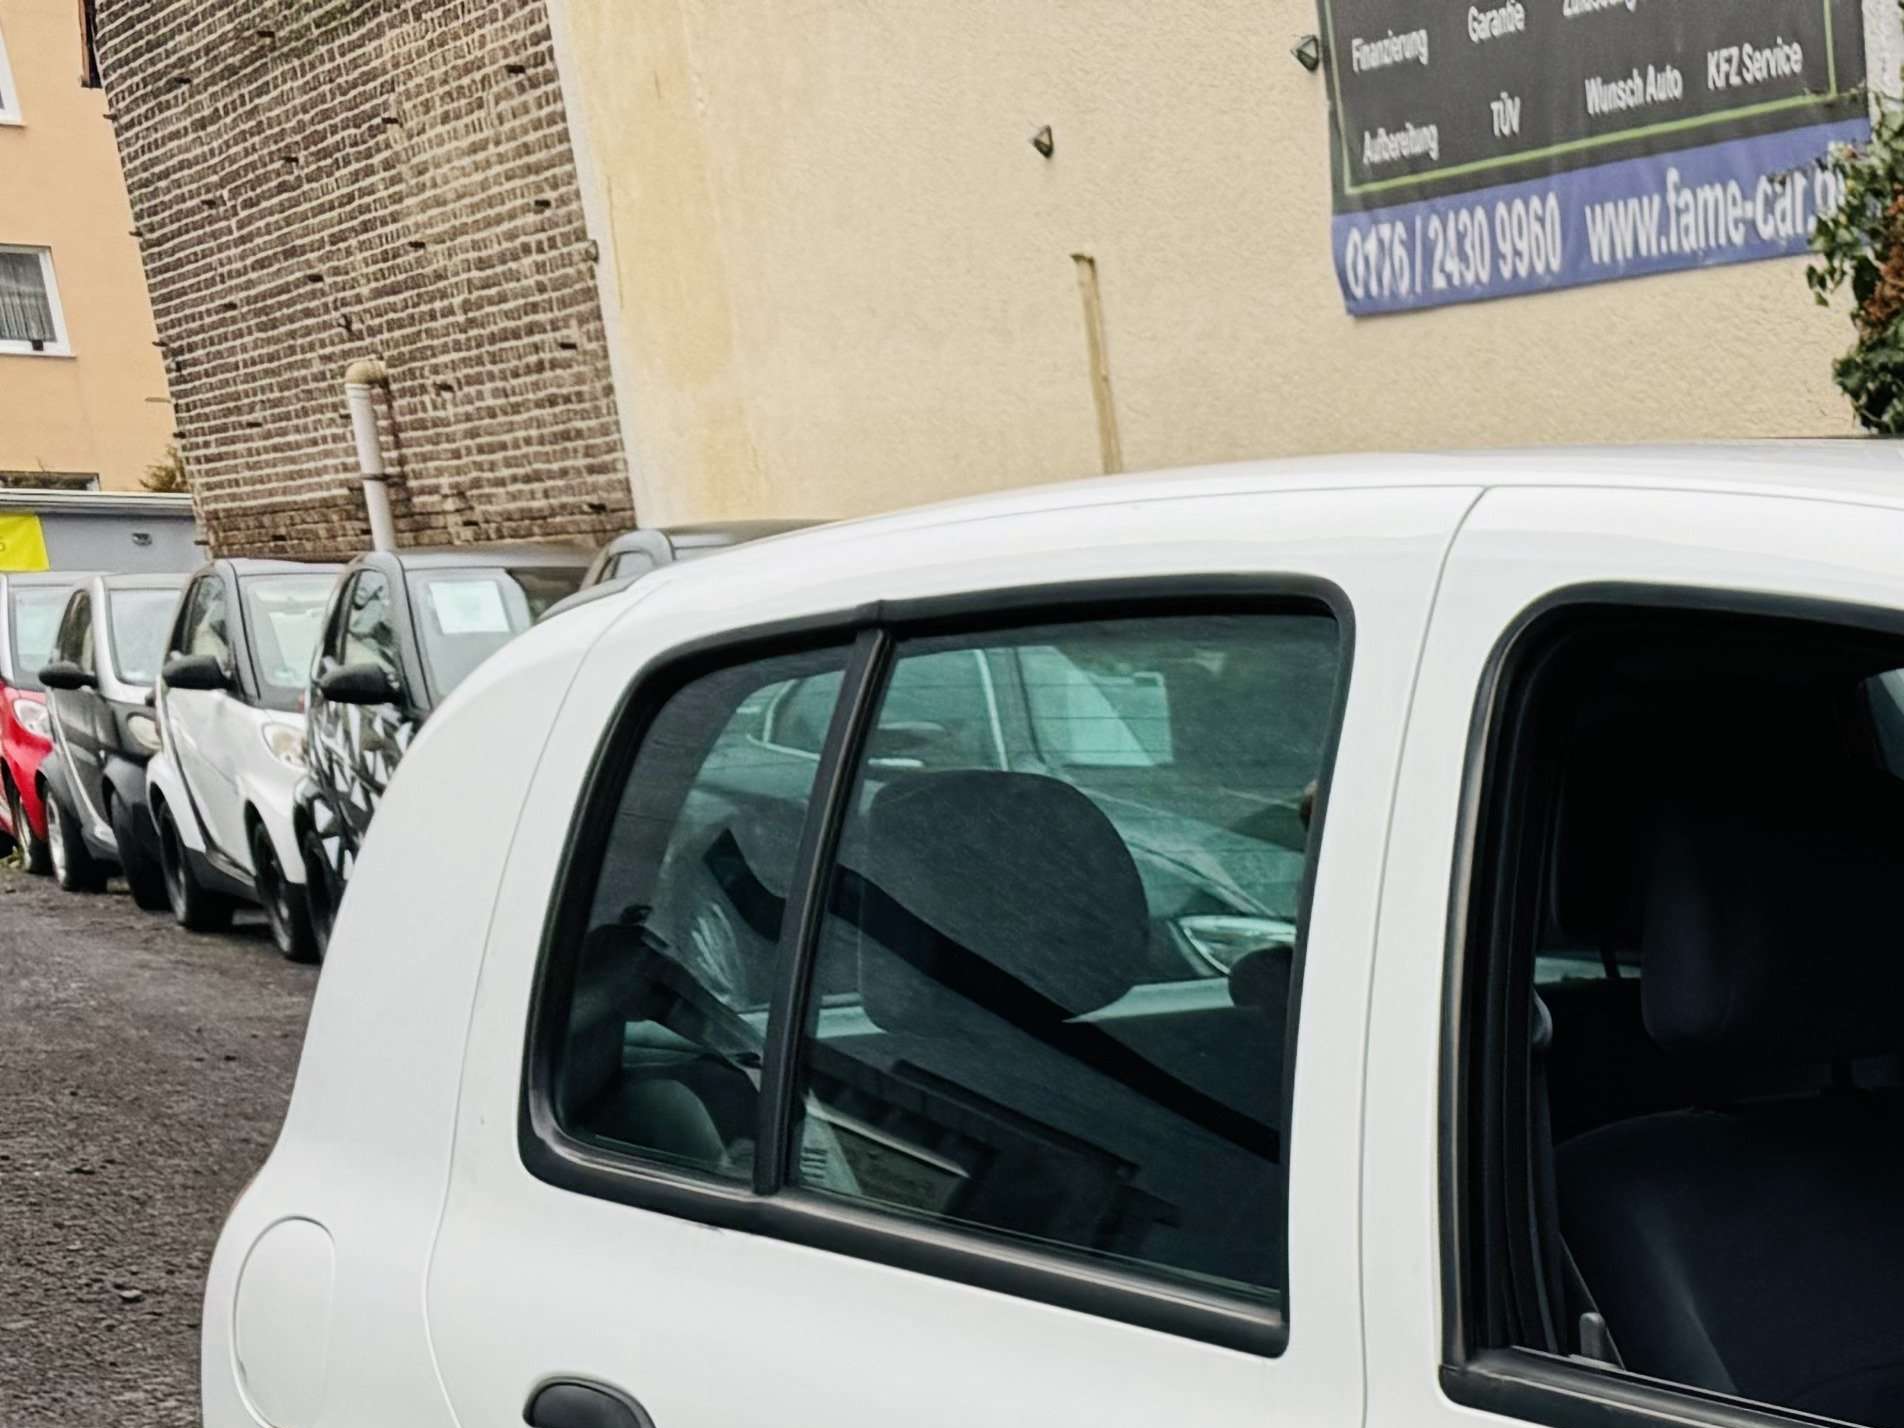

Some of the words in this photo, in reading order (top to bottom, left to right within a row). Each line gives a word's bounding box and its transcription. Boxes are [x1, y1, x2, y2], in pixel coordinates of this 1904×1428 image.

[1468, 0, 1525, 43] Garantie
[1707, 46, 1742, 90] KFZ
[1743, 36, 1803, 84] Service
[1490, 91, 1521, 137] TÜV
[1585, 68, 1643, 116] Wunsch
[1645, 64, 1683, 101] Auto
[1345, 220, 1410, 299] 0176
[1415, 214, 1422, 294] /
[1428, 205, 1490, 289] 2430
[1495, 192, 1562, 281] 9960
